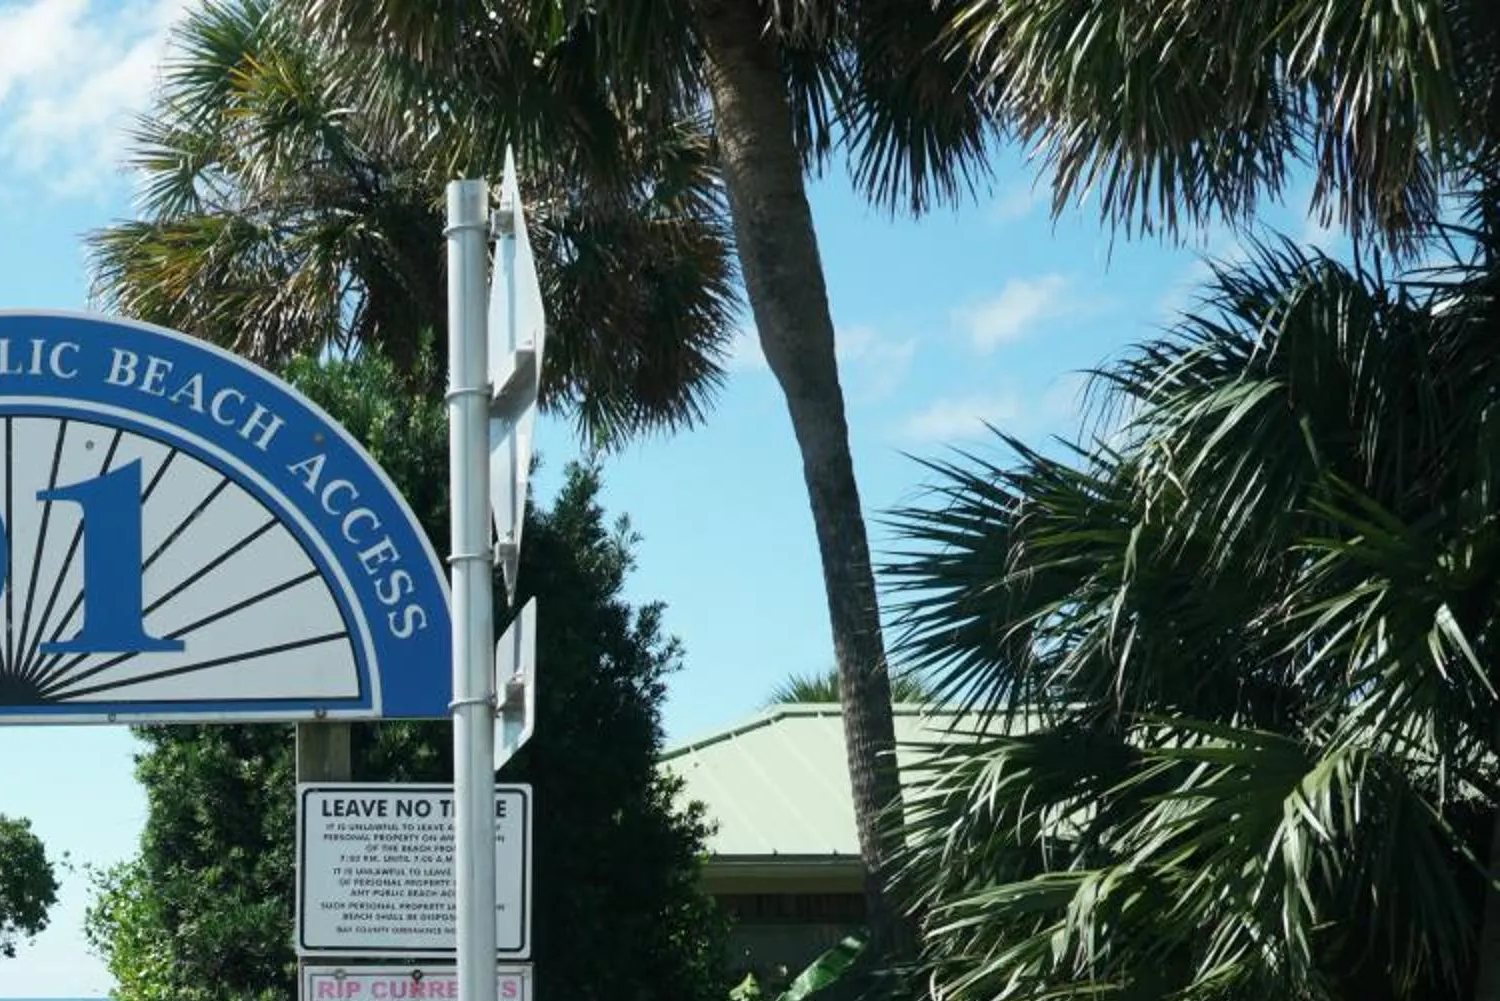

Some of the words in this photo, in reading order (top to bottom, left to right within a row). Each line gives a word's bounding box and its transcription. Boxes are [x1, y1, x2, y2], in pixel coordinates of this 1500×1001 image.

[104, 348, 285, 452] BEACH
[286, 452, 428, 640] ACCESS
[321, 799, 388, 818] LEAVE
[396, 799, 431, 818] NO
[374, 833, 419, 842] PROPERTY
[353, 878, 401, 887] PERSONAL
[404, 878, 450, 887] PROPERTY
[372, 889, 404, 897] PUBLIC
[348, 901, 396, 910] PERSONAL
[316, 981, 362, 999] RIP
[371, 981, 517, 999] CURRES
